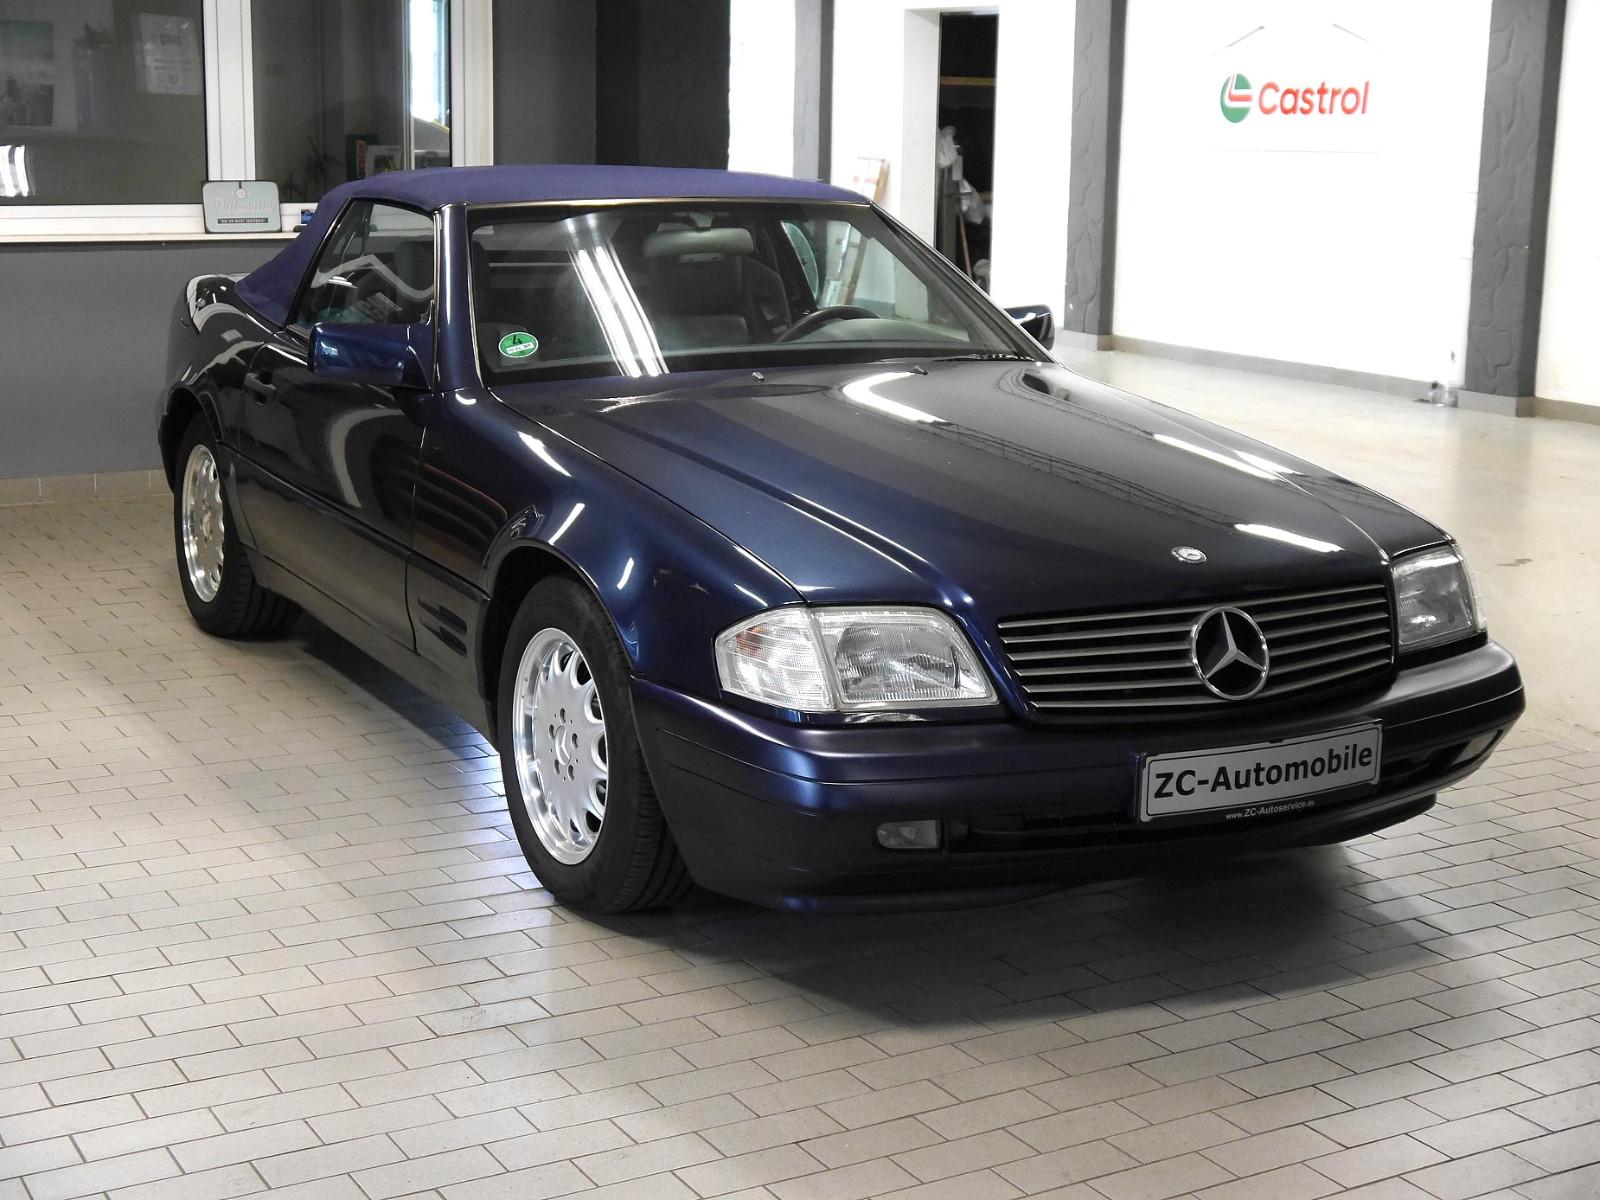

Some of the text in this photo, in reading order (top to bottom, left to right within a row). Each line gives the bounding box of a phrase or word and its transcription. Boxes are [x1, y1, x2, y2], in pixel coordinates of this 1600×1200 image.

[1259, 80, 1369, 115] Castrol
[512, 334, 523, 345] 4
[1154, 744, 1373, 799] ZC-Automobile
[1225, 800, 1315, 820] www.ZC-Autoservice.de
